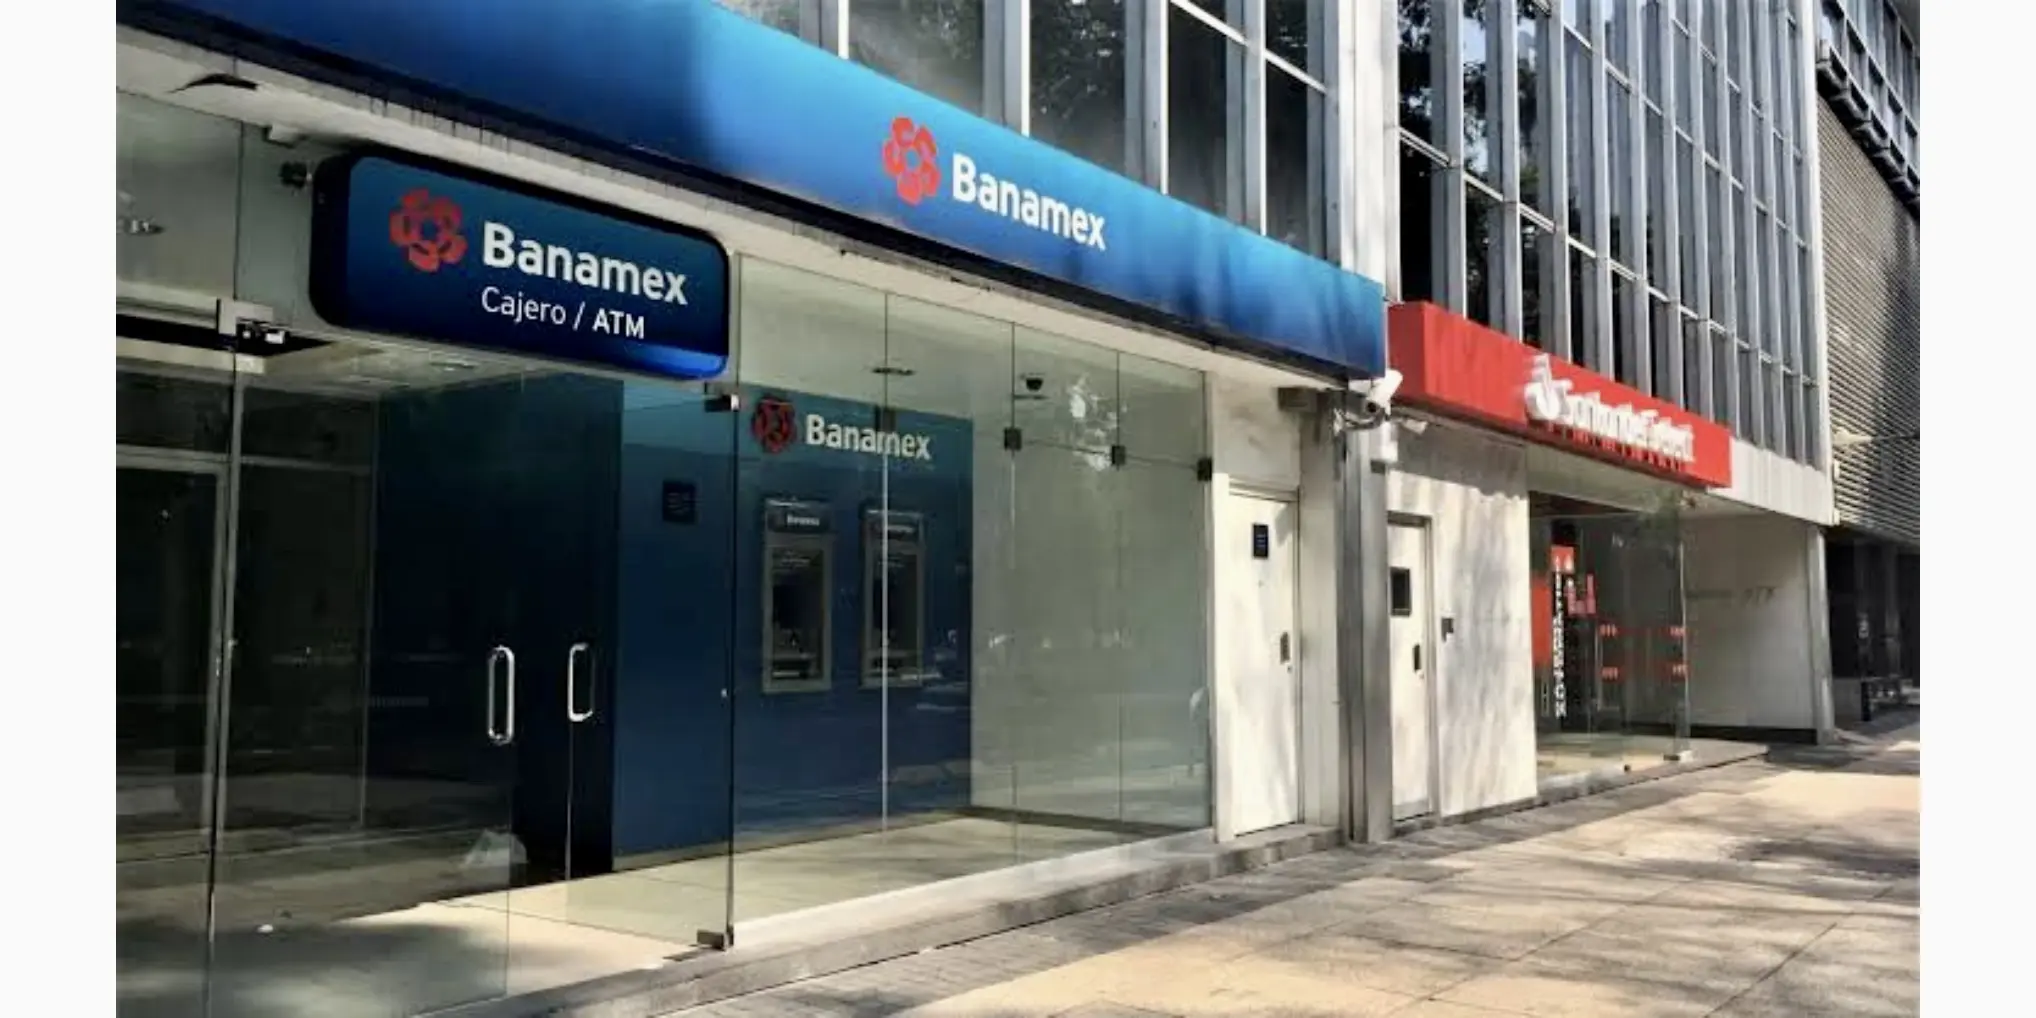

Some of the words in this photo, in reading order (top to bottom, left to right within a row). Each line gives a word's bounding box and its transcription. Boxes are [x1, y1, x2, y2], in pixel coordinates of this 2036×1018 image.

[952, 153, 1106, 251] Banamex
[483, 221, 688, 306] Banamex
[481, 286, 566, 325] Cajero
[592, 308, 645, 339] ATM
[805, 413, 932, 462] Banamex
